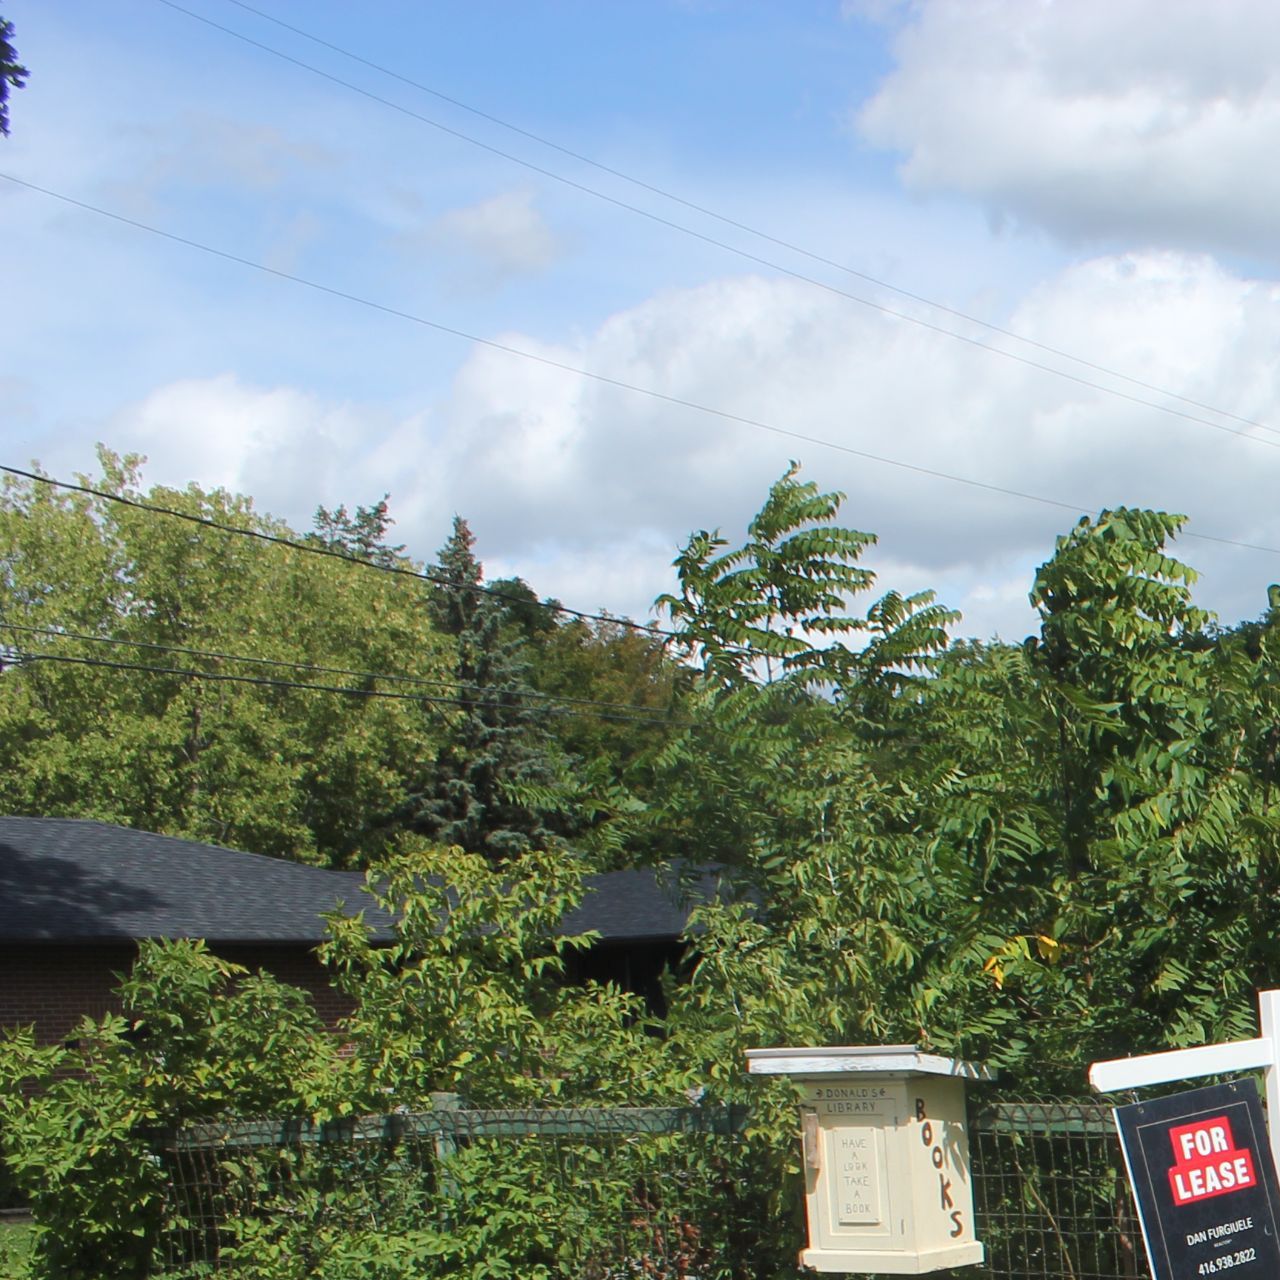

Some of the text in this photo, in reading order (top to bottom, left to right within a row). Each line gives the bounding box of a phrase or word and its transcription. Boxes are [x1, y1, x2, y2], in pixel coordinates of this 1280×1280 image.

[826, 1088, 878, 1098] DONALD'S
[827, 1102, 876, 1113] LIBRARY
[842, 1138, 867, 1149] HAVE
[1179, 1125, 1228, 1160] FOR
[852, 1151, 858, 1160] A
[843, 1176, 870, 1187] TAKE
[1174, 1158, 1250, 1201] LEASE
[854, 1189, 860, 1199] A
[846, 1203, 870, 1214] BOOK
[1186, 1217, 1254, 1246] DAN FURGIUELE
[1198, 1247, 1257, 1276] 416.938.2822
